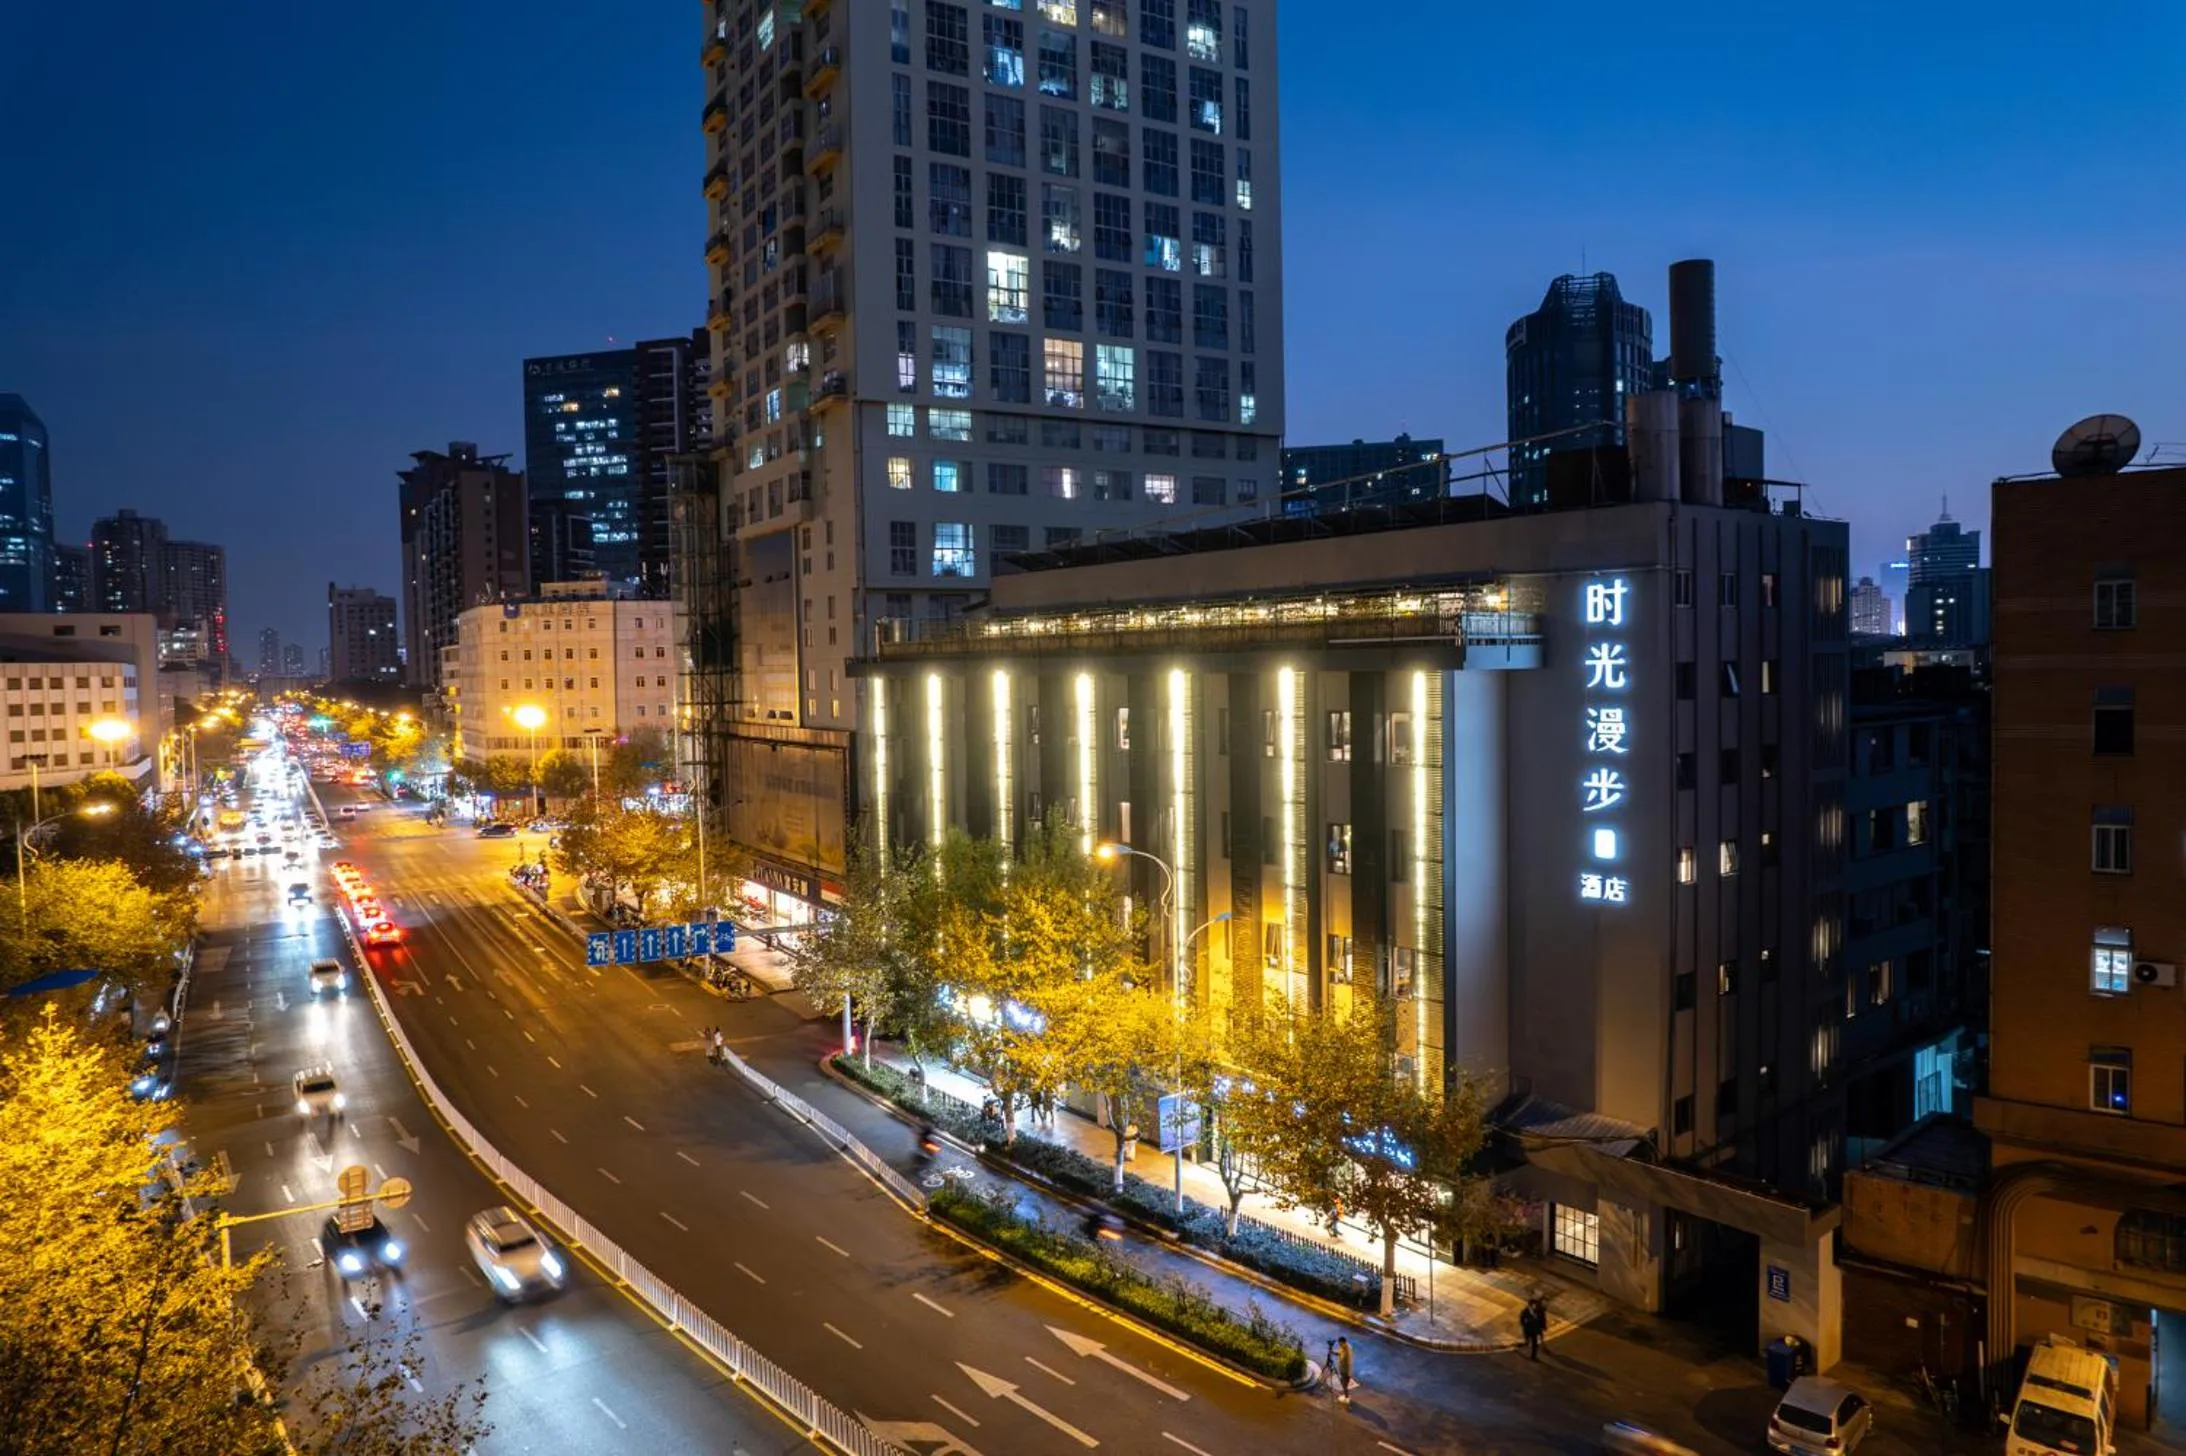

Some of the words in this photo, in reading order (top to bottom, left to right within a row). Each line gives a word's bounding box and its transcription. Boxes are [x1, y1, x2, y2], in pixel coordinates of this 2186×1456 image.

[1583, 578, 1629, 812] 时光漫步
[1580, 873, 1627, 902] 酒店
